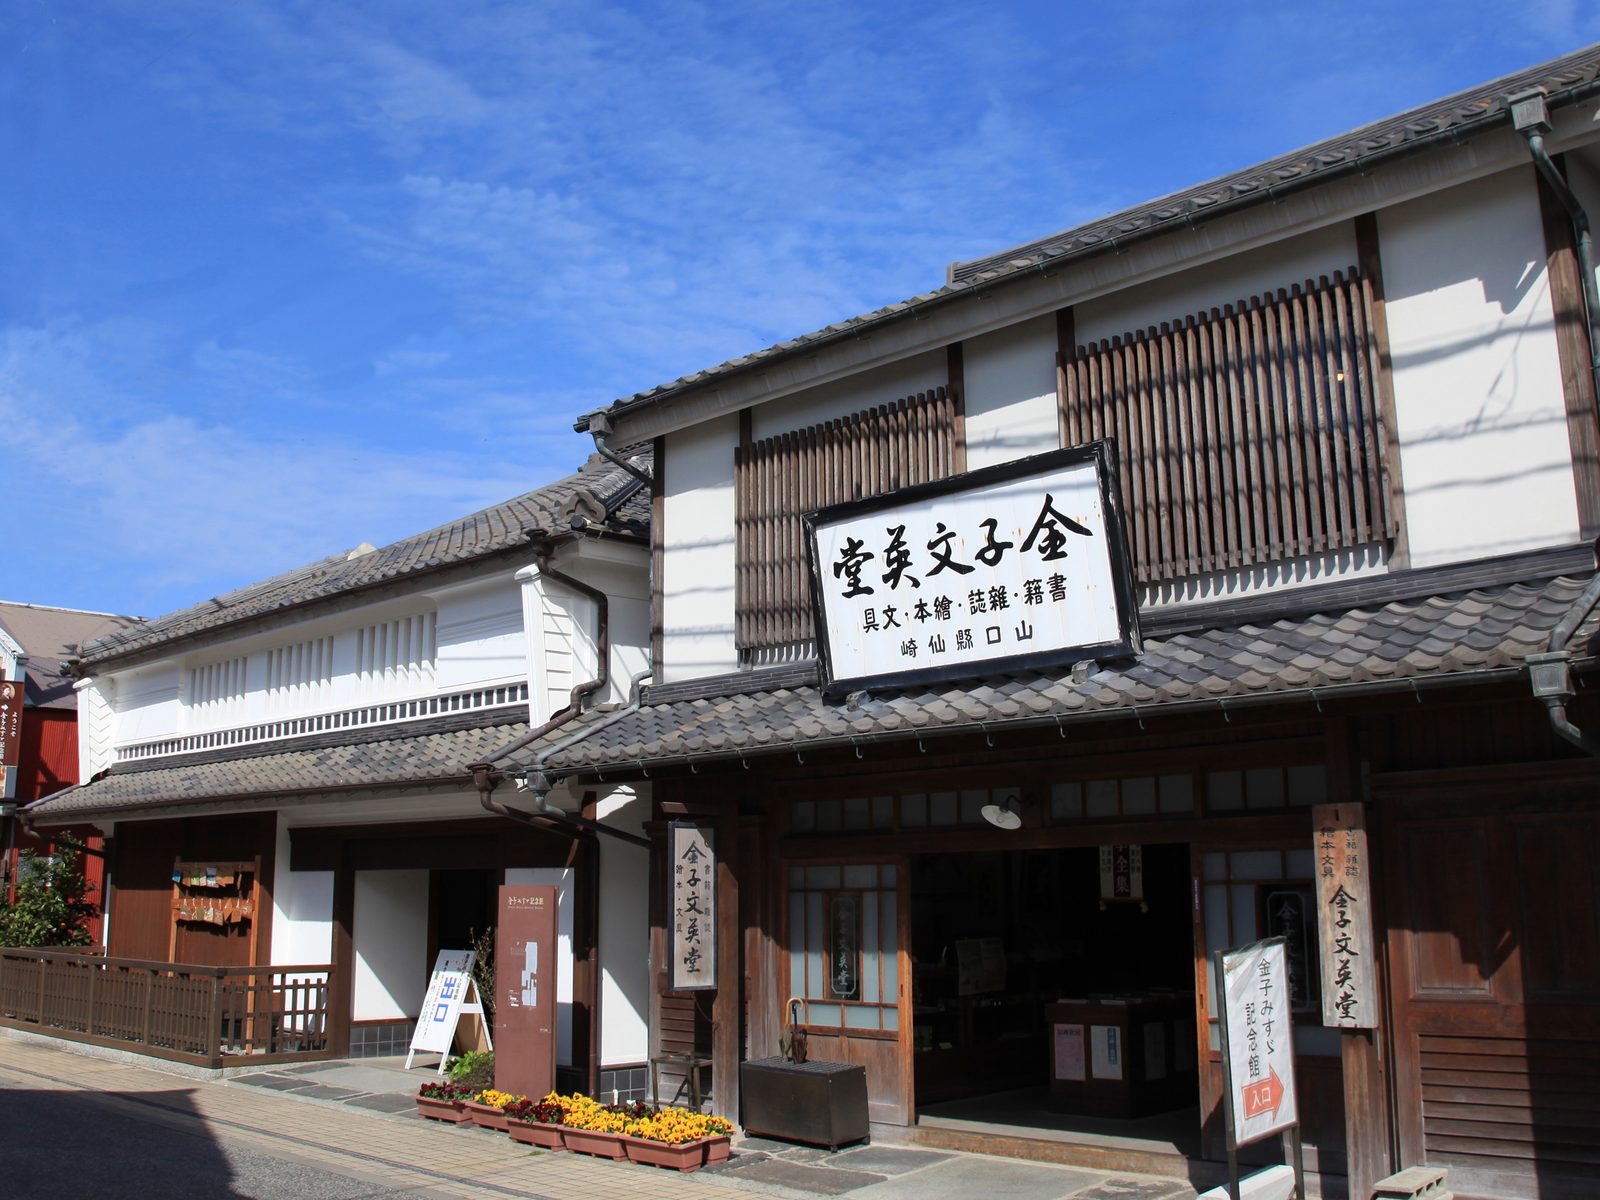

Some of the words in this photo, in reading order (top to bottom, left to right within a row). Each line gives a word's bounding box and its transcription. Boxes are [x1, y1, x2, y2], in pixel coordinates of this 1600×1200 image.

[833, 493, 1093, 599] 金子文英堂
[681, 840, 708, 973] 金子文英堂
[1328, 884, 1360, 1020] 金子文英堂
[433, 976, 458, 1023] 出口
[1244, 1002, 1261, 1078] 記念館
[1252, 1087, 1272, 1110] 入口
